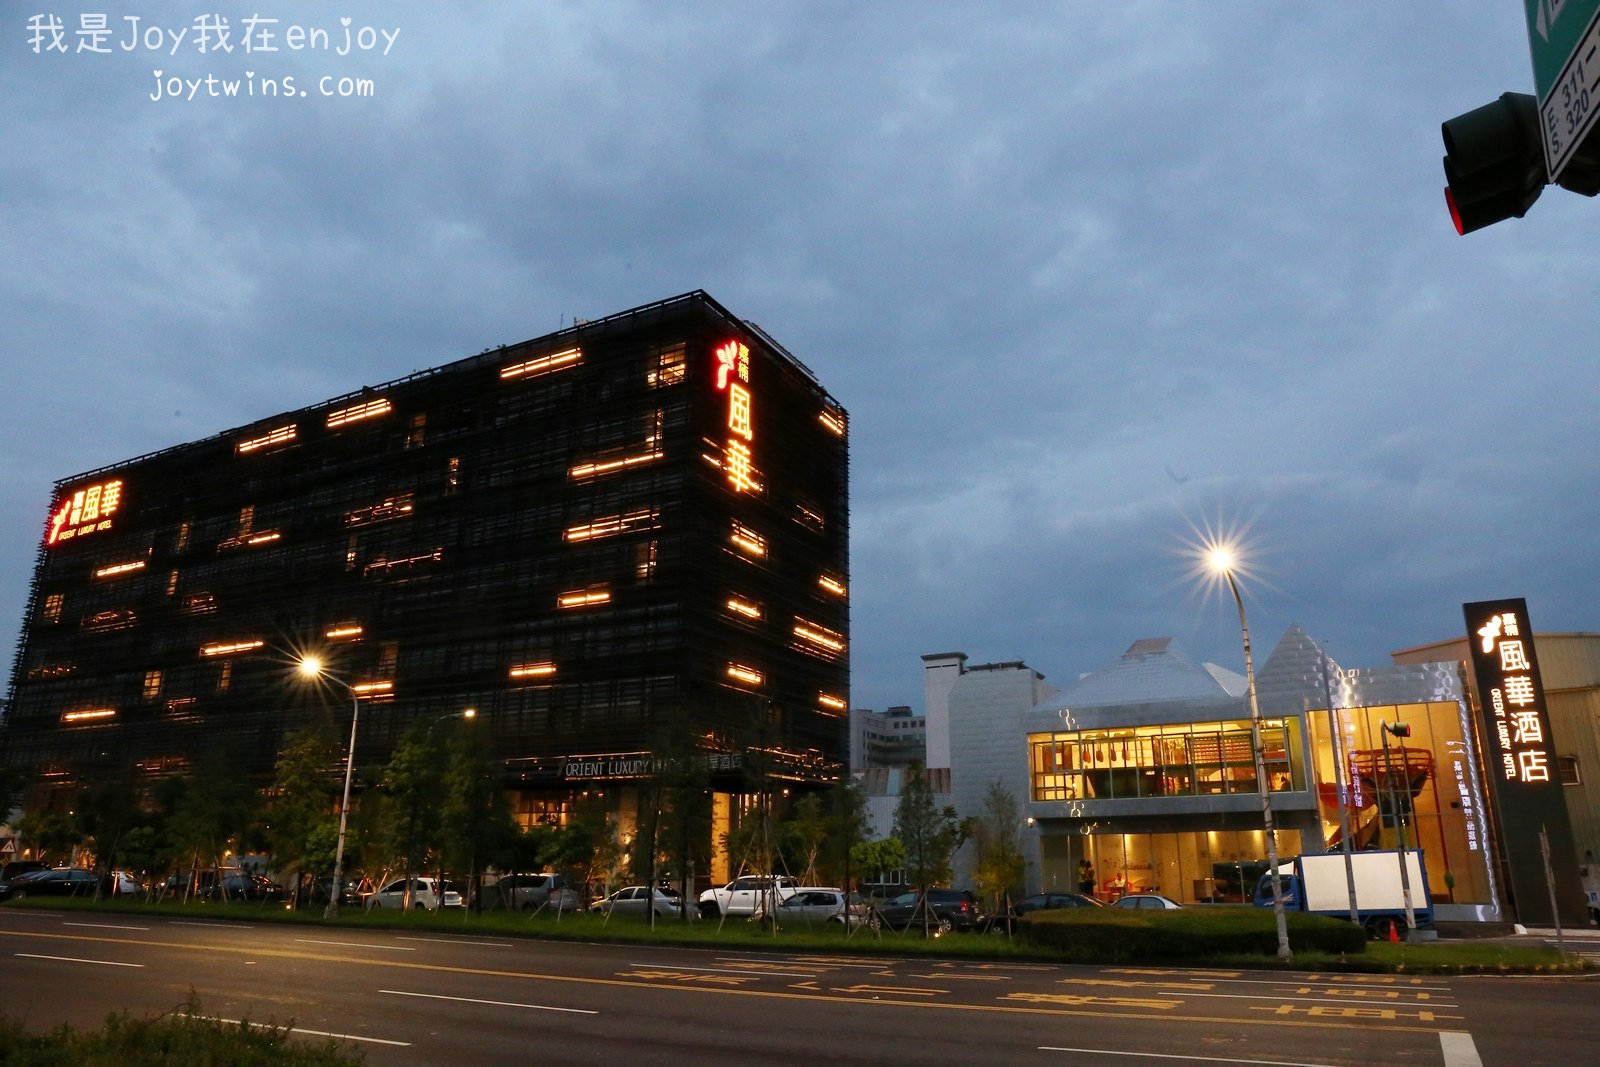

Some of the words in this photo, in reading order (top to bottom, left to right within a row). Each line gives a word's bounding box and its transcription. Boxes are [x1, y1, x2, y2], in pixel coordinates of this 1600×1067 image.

[1490, 688, 1506, 717] ORIENT
[1496, 720, 1511, 750] LUXURY
[565, 761, 605, 777] ORIENT
[608, 759, 648, 775] LUXURY
[1502, 753, 1517, 780] HOTEL
